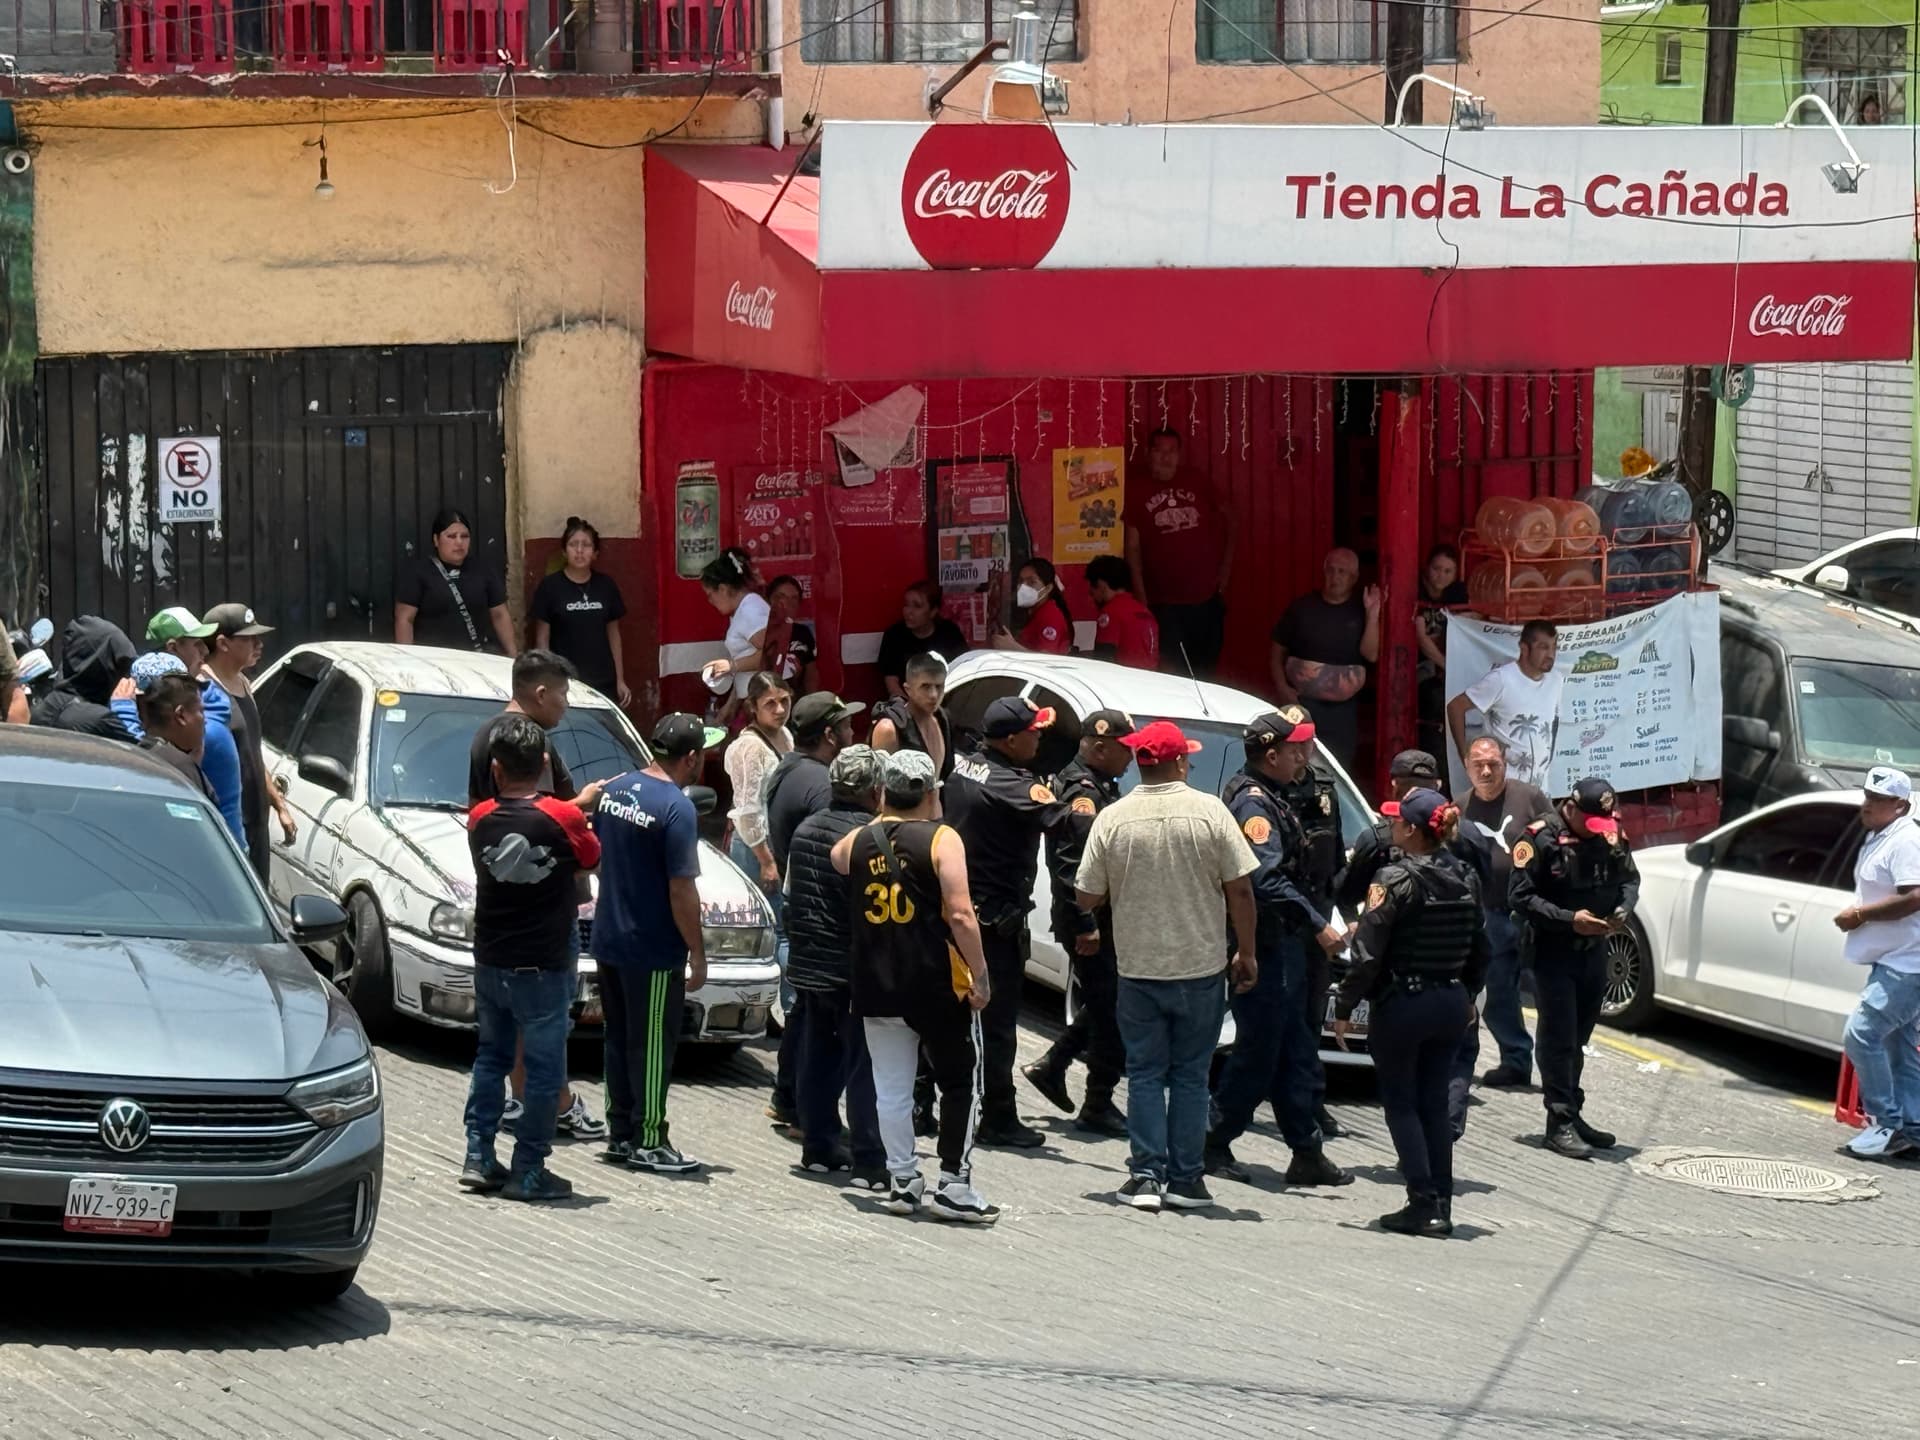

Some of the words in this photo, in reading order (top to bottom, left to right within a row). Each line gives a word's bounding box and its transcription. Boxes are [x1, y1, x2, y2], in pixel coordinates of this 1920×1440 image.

[914, 168, 1058, 219] Coca-Cola
[1286, 172, 1481, 219] Tienda
[1500, 175, 1566, 218] La
[1585, 170, 1789, 218] Cañada
[726, 280, 778, 330] Coca-Cola
[1749, 294, 1853, 336] Coca-Cola
[173, 490, 208, 508] NO
[940, 567, 978, 582] FAVORITO
[566, 601, 603, 611] adidas
[1575, 623, 1623, 641] SEMANA
[599, 792, 656, 829] Frontier
[864, 882, 915, 924] 30
[70, 1193, 171, 1220] NVZ-939-C
